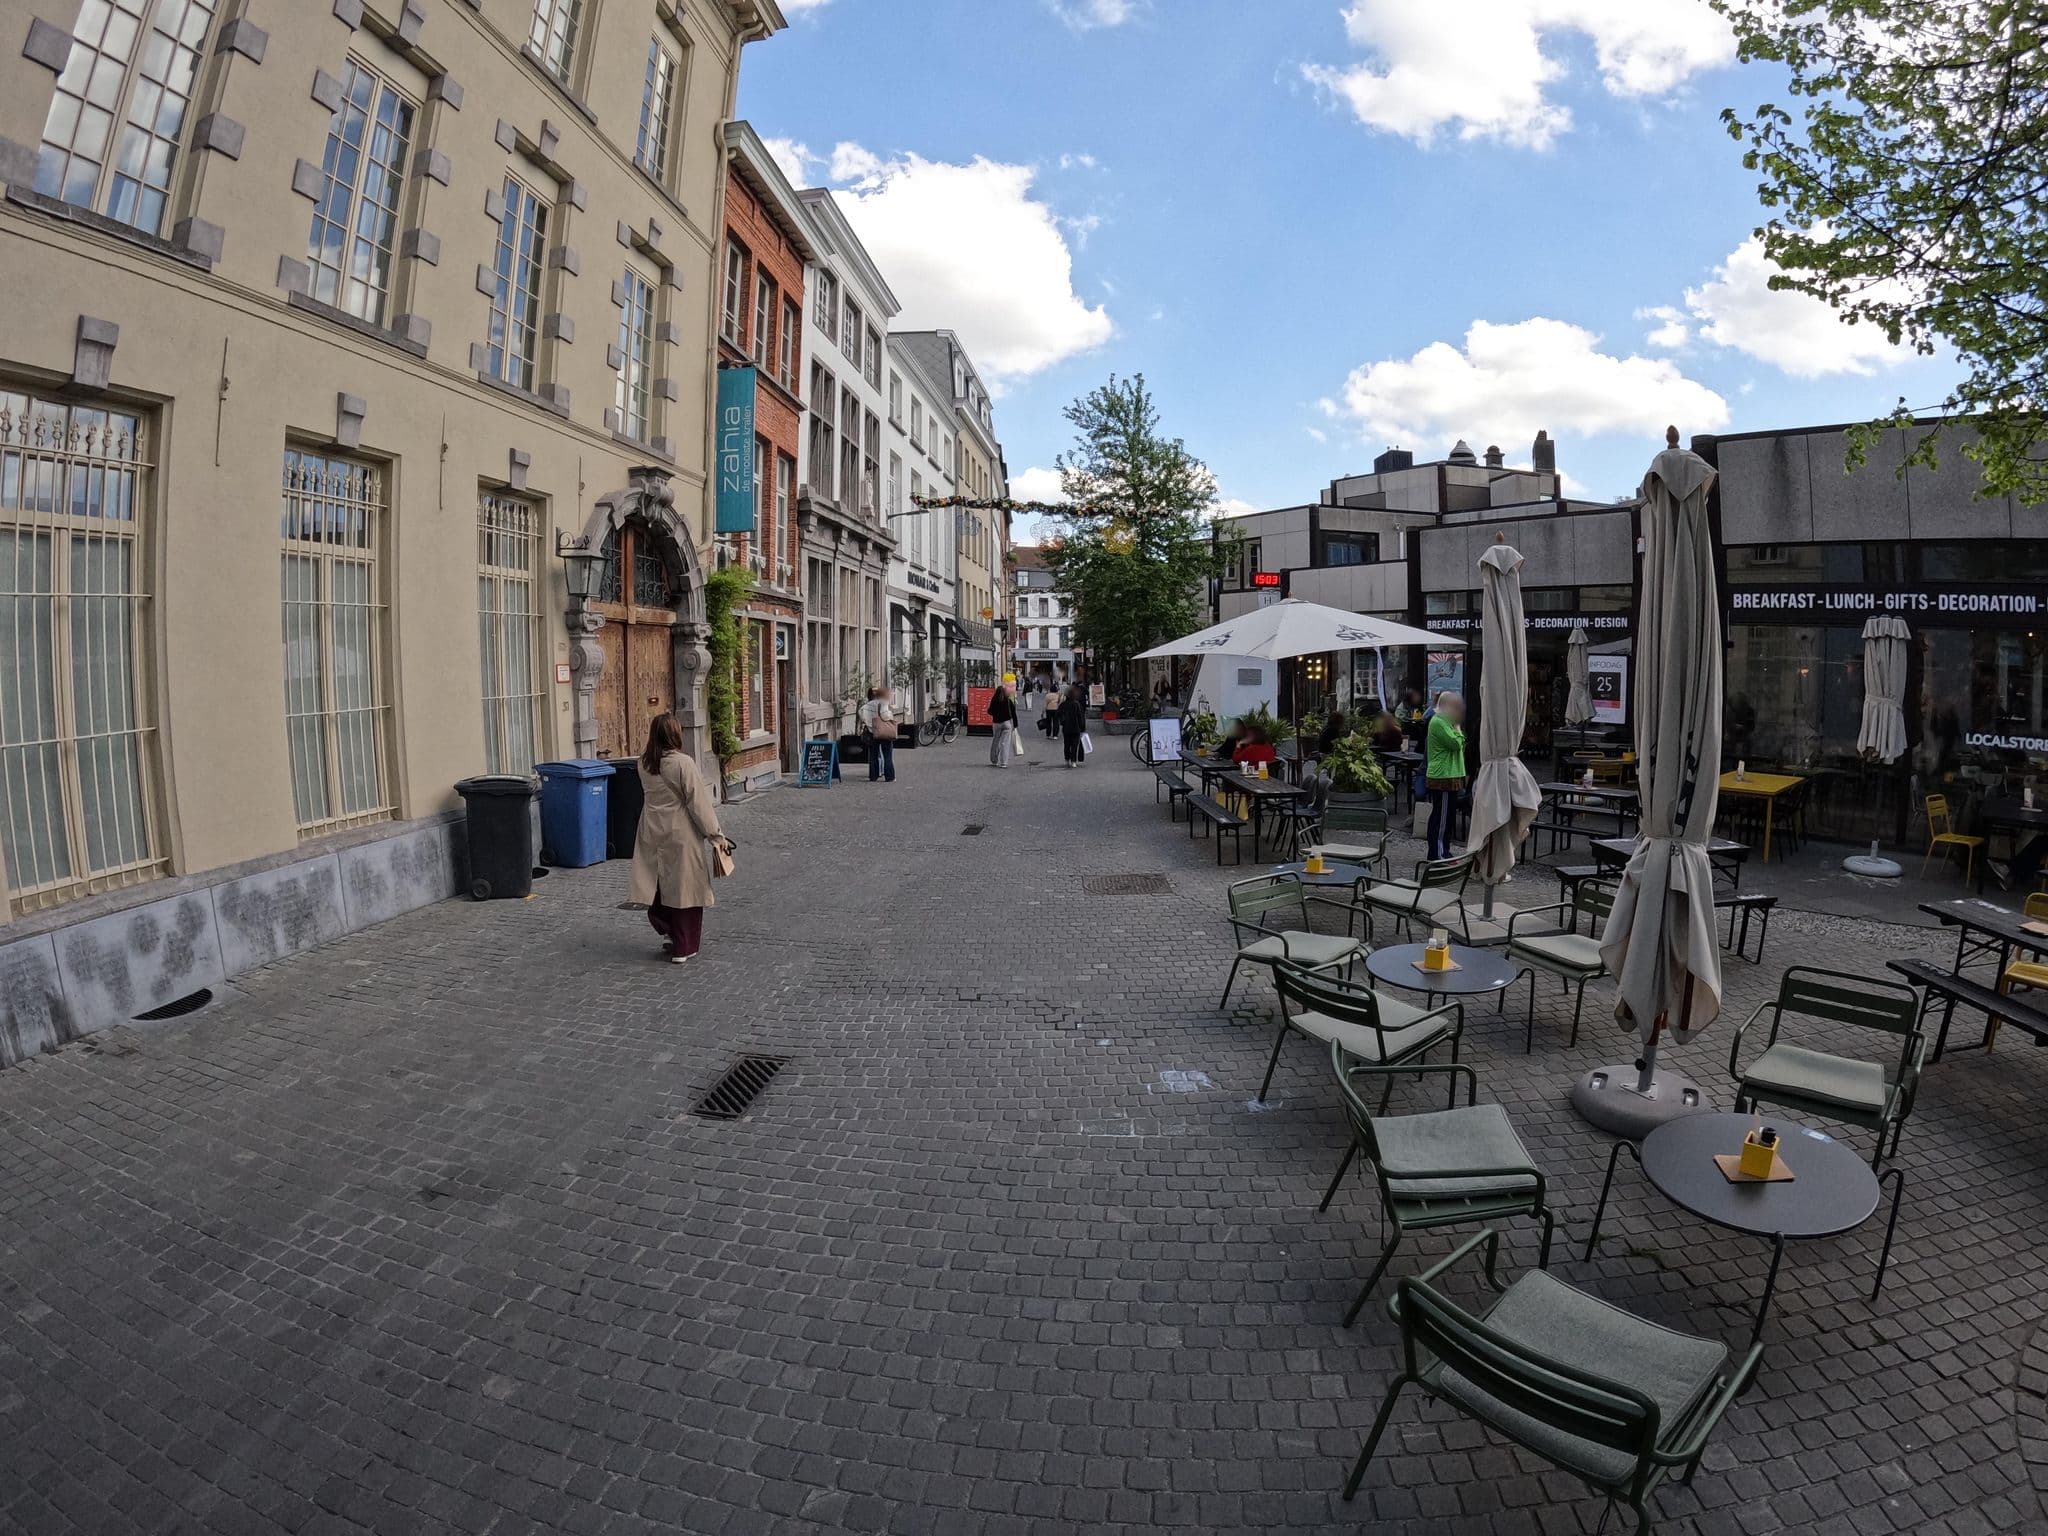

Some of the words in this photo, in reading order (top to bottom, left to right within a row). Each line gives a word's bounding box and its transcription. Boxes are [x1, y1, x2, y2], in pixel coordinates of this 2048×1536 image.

[743, 405, 751, 435] kralen
[720, 406, 740, 493] zahia
[742, 478, 750, 492] de
[1733, 593, 1816, 609] BREAKFAST
[1825, 593, 1875, 609] LUNCH
[1884, 593, 1928, 610] GIFTS
[1938, 594, 2037, 613] DECORATION
[1427, 619, 1471, 629] BREAKFAST
[1594, 617, 1628, 628] DESIGN
[1336, 632, 1384, 640] SPA
[1597, 677, 1612, 692] 25
